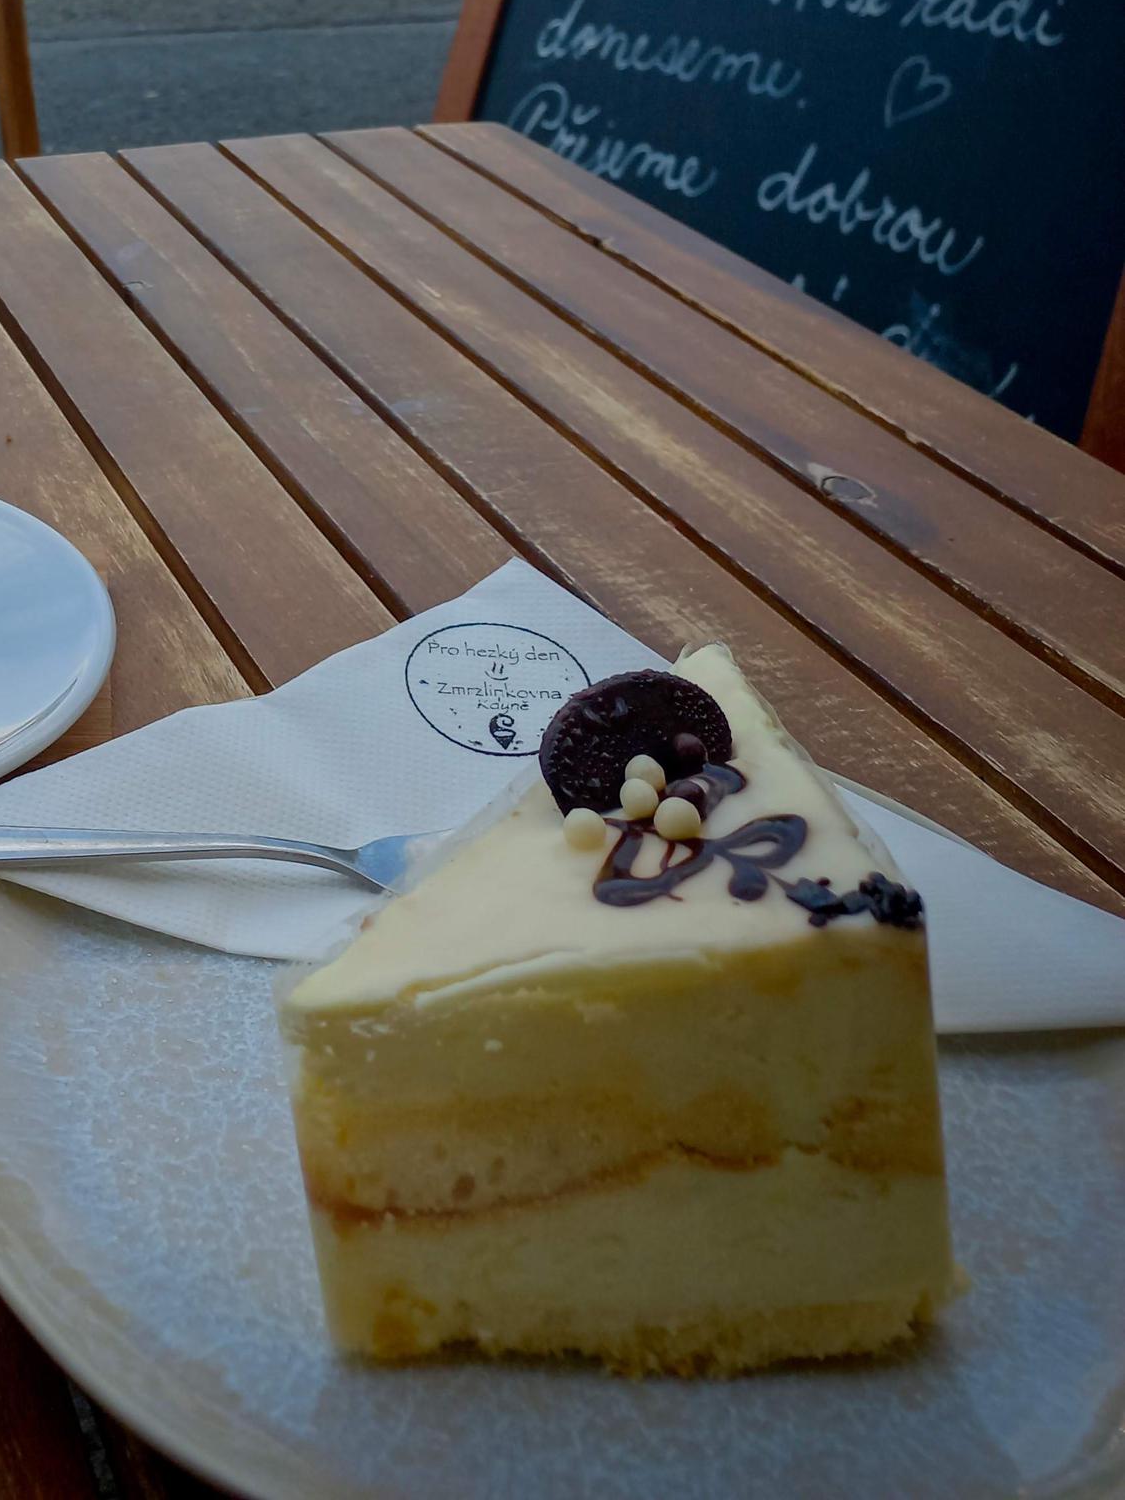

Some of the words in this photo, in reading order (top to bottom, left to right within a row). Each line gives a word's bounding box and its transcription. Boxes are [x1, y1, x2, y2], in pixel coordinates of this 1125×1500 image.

[757, 142, 984, 276] dobrou
[427, 640, 460, 656] Pro
[464, 641, 520, 666] hezký
[524, 645, 561, 661] den
[436, 681, 563, 700] Zmrzlinkovna
[476, 697, 530, 715] Kdyně
